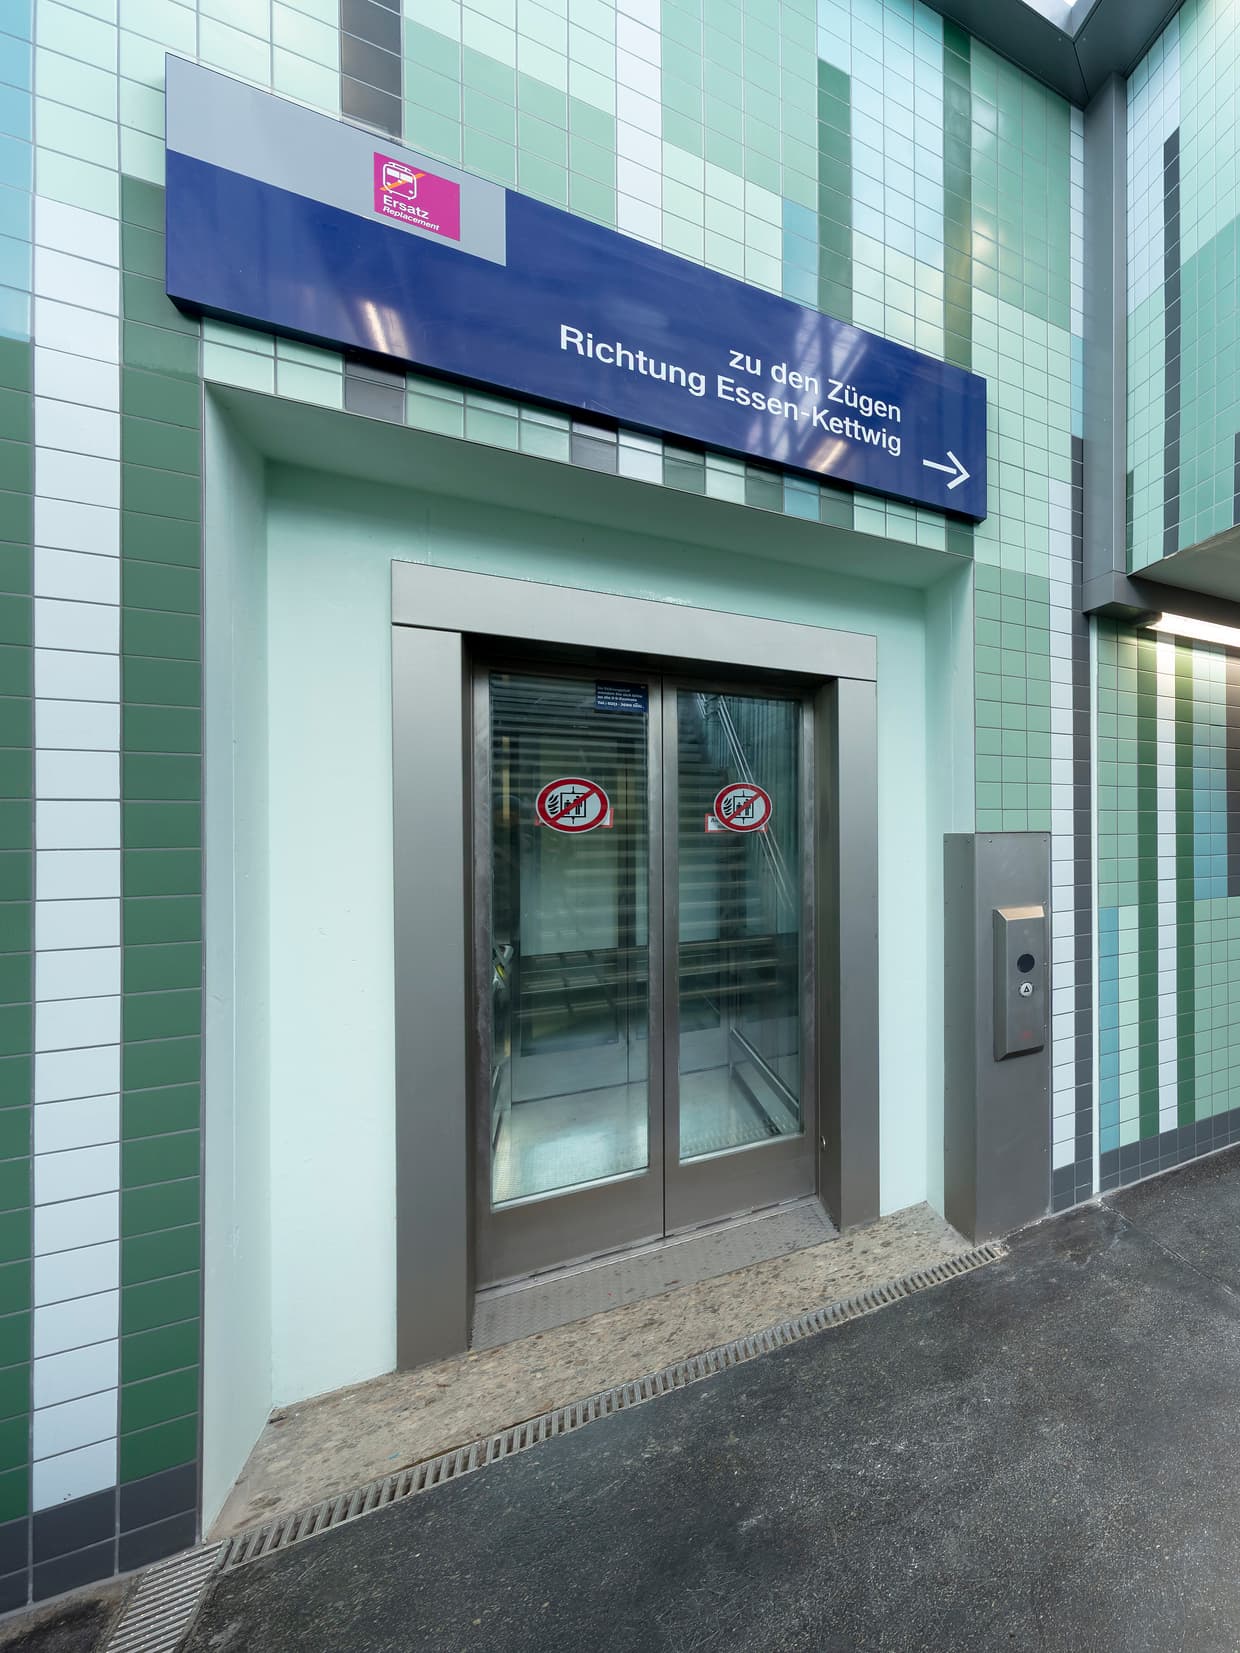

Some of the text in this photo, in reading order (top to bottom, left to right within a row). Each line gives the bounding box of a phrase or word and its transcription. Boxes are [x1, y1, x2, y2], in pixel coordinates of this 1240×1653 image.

[382, 205, 441, 232] Replacement
[383, 194, 430, 220] Ersatz
[560, 323, 902, 457] Richtung Essen-Kettwig
[728, 349, 902, 423] zu den Zügen
